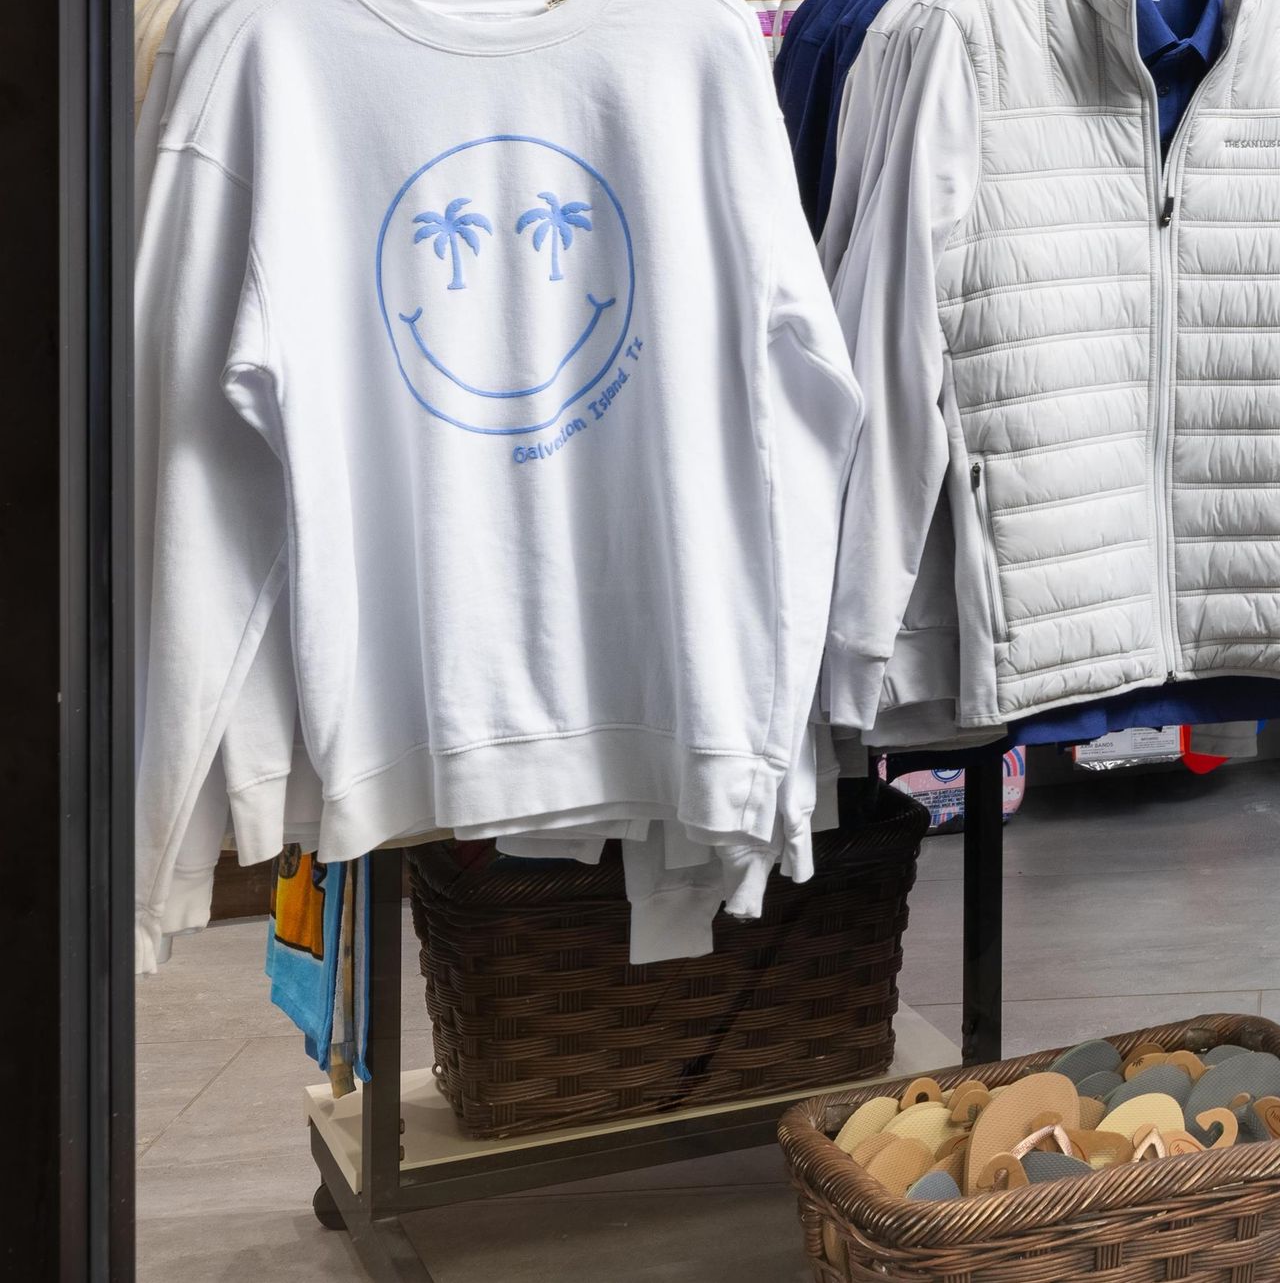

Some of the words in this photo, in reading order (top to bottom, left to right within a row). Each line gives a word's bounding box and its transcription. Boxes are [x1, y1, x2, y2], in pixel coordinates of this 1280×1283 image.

[1224, 139, 1241, 149] THE
[1240, 139, 1259, 149] SAN
[1259, 139, 1276, 149] LUIS
[512, 416, 587, 464] Galveston
[587, 367, 631, 420] Island
